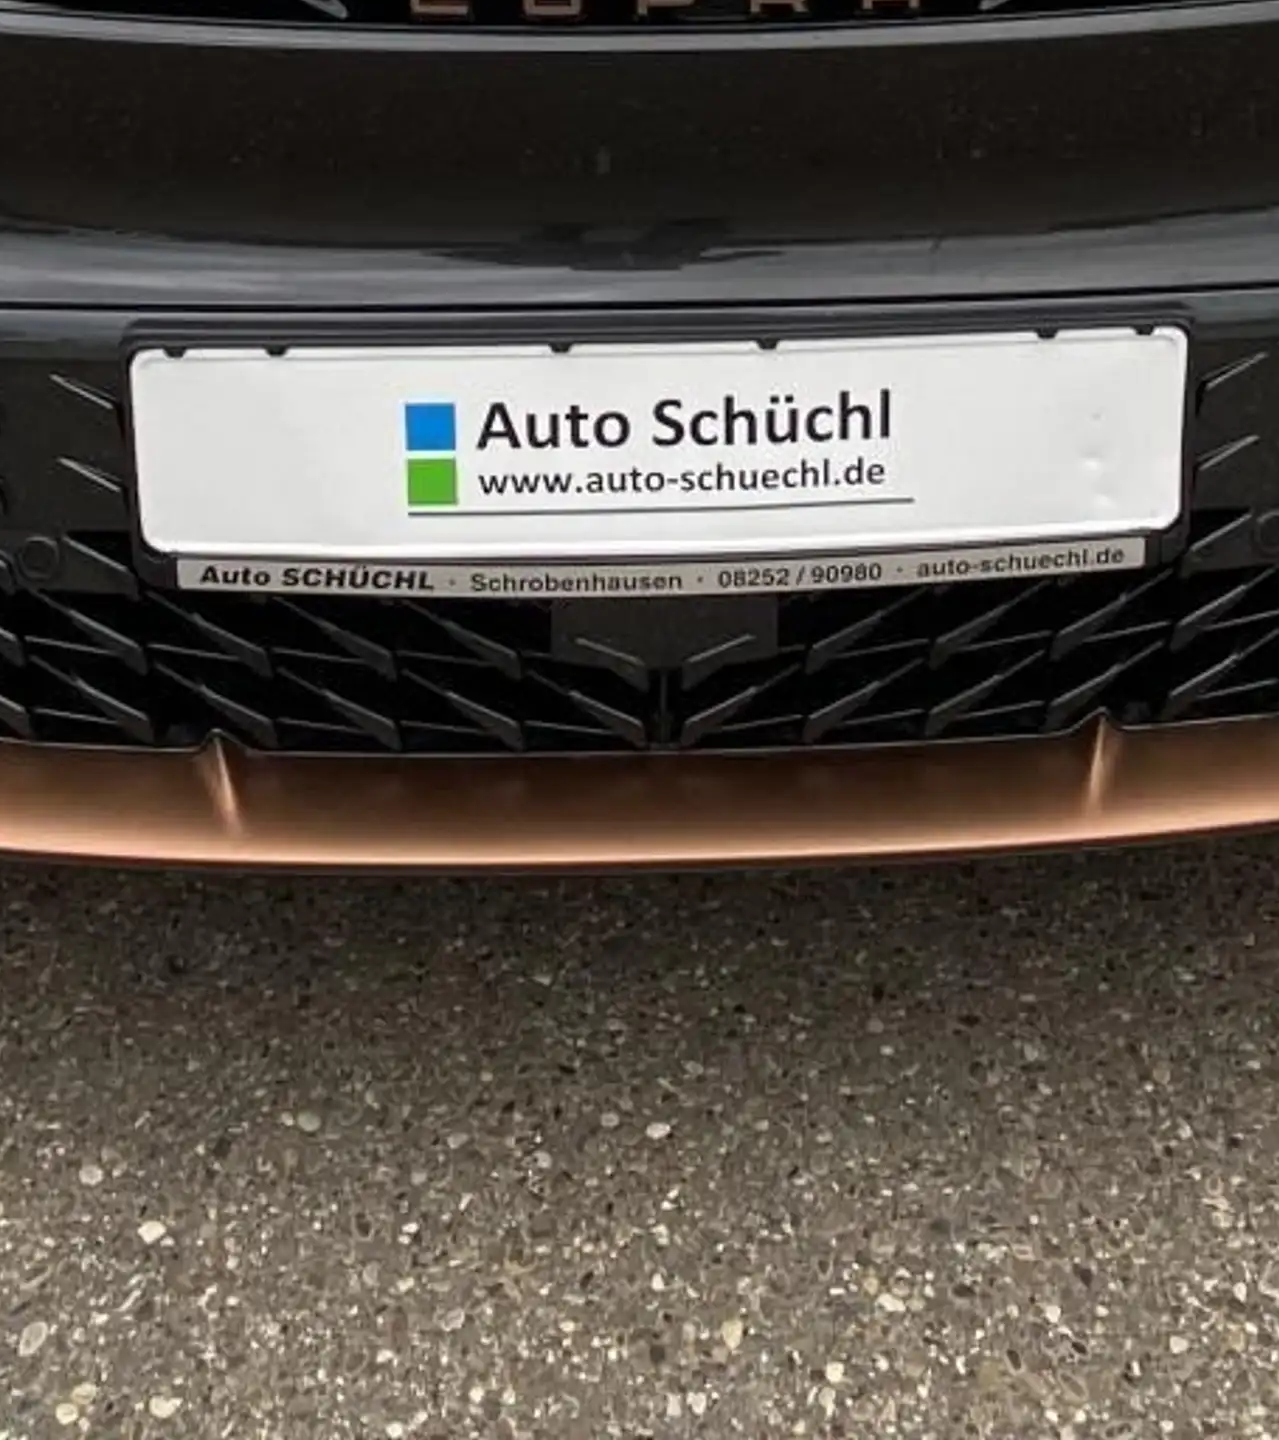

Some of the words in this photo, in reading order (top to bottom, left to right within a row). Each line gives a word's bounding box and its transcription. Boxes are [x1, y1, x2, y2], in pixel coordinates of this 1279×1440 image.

[477, 402, 630, 450] Auto
[652, 389, 890, 446] Schüchl
[478, 457, 886, 495] www.auto-schuechl.de
[200, 564, 270, 587] Auto
[281, 564, 434, 591] SCHÜCHL
[471, 572, 682, 593] Schrobenhausen
[720, 568, 789, 588] 08252
[812, 563, 882, 584] 90980
[917, 547, 1126, 578] auto-schuechl.de
